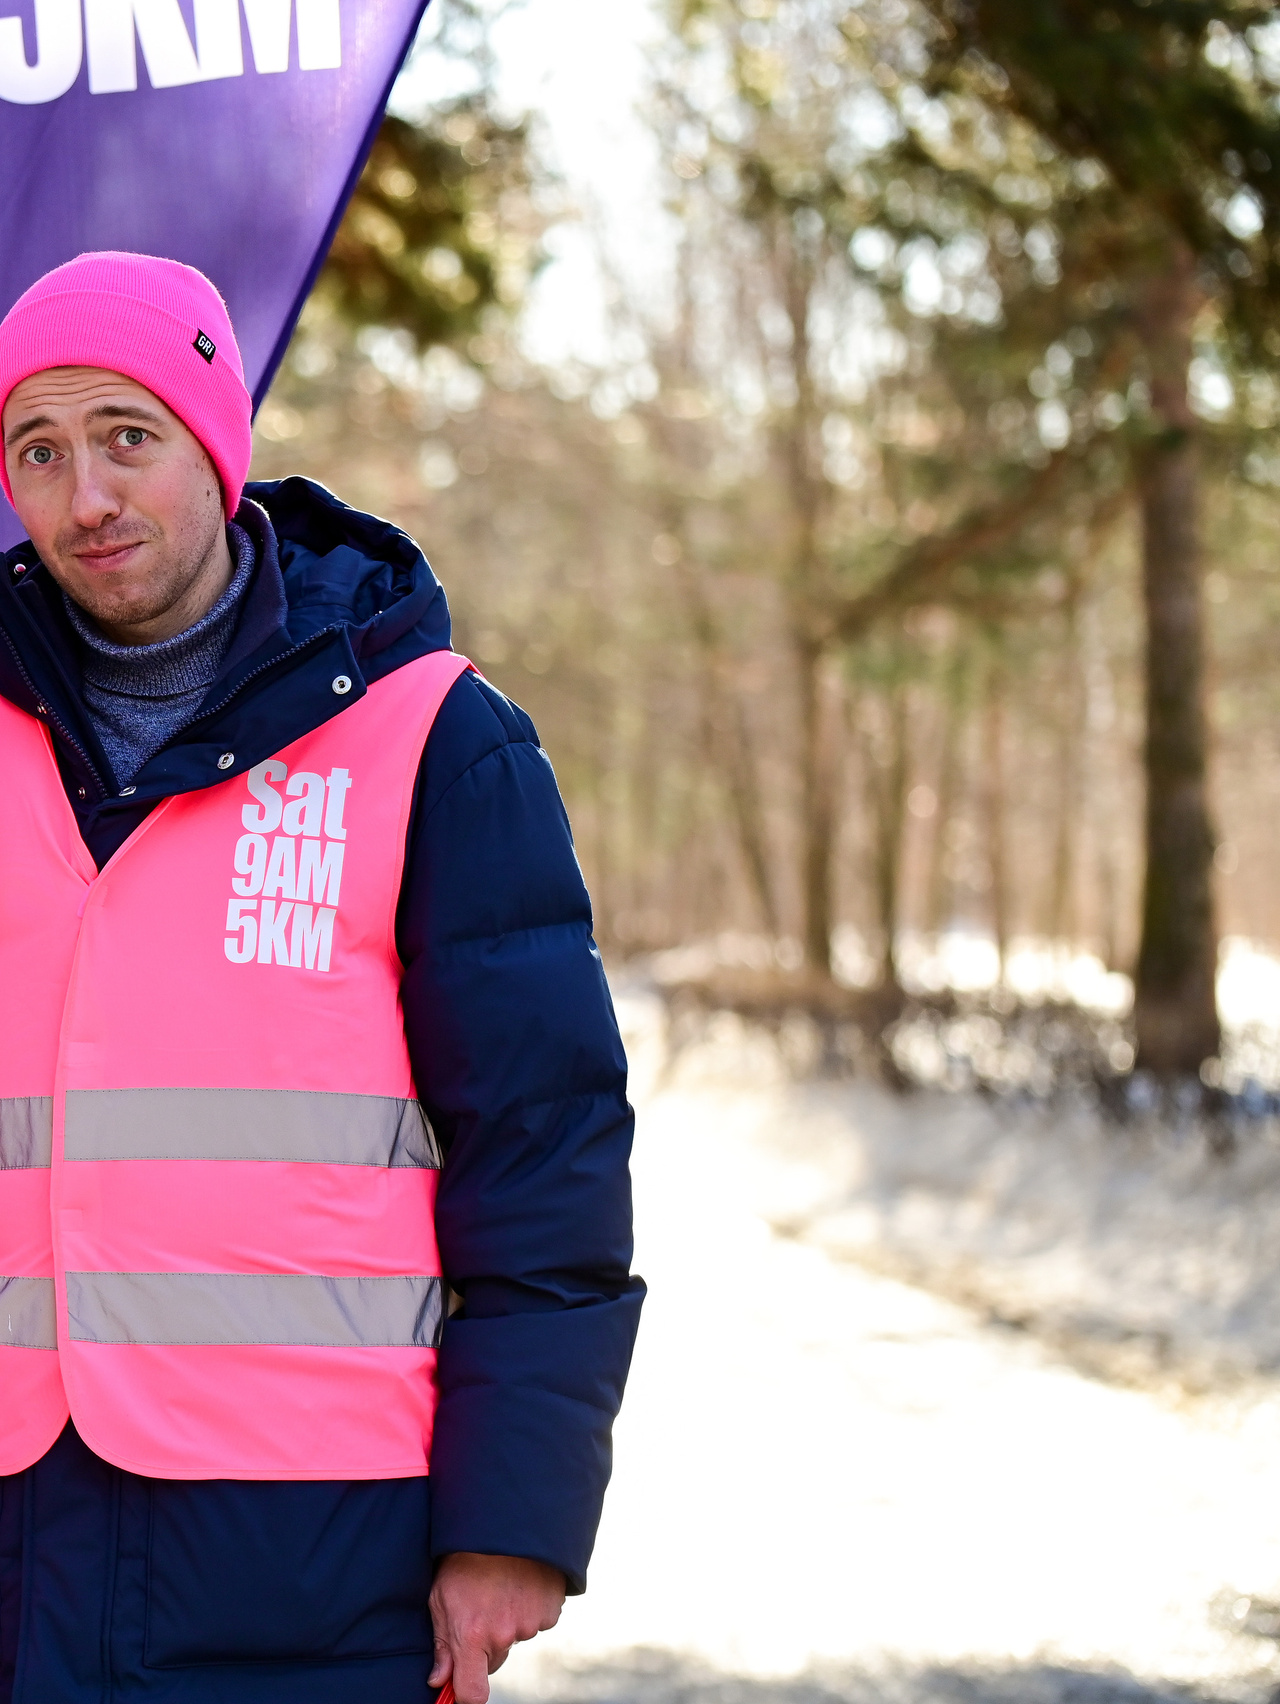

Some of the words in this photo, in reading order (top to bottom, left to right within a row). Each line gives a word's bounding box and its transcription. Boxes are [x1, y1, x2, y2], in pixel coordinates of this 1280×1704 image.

[241, 759, 353, 841] Sat
[231, 833, 346, 907] 9AM
[224, 898, 337, 972] 5KM
